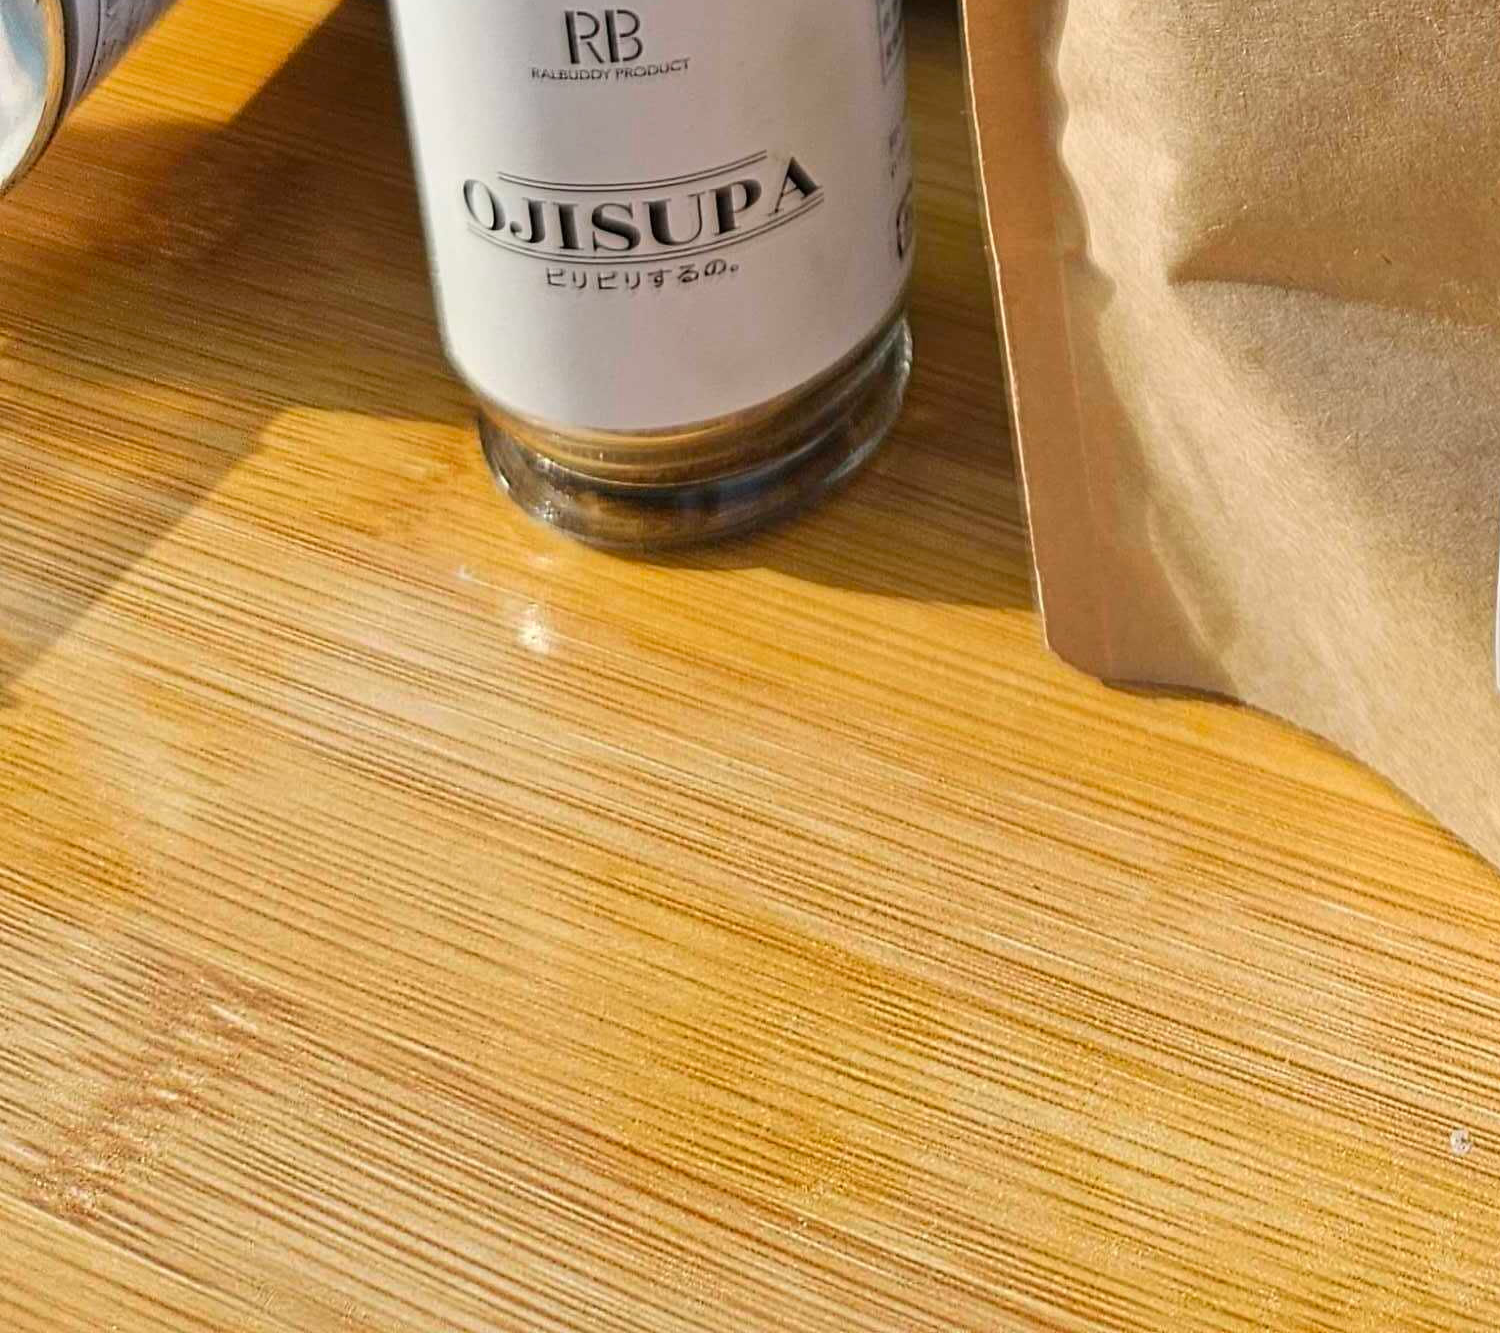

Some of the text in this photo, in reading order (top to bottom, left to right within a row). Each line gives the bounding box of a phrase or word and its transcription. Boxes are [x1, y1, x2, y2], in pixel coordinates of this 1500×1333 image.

[564, 8, 643, 64] RB
[615, 58, 691, 80] PRODUCT
[462, 156, 822, 253] OJISUPA
